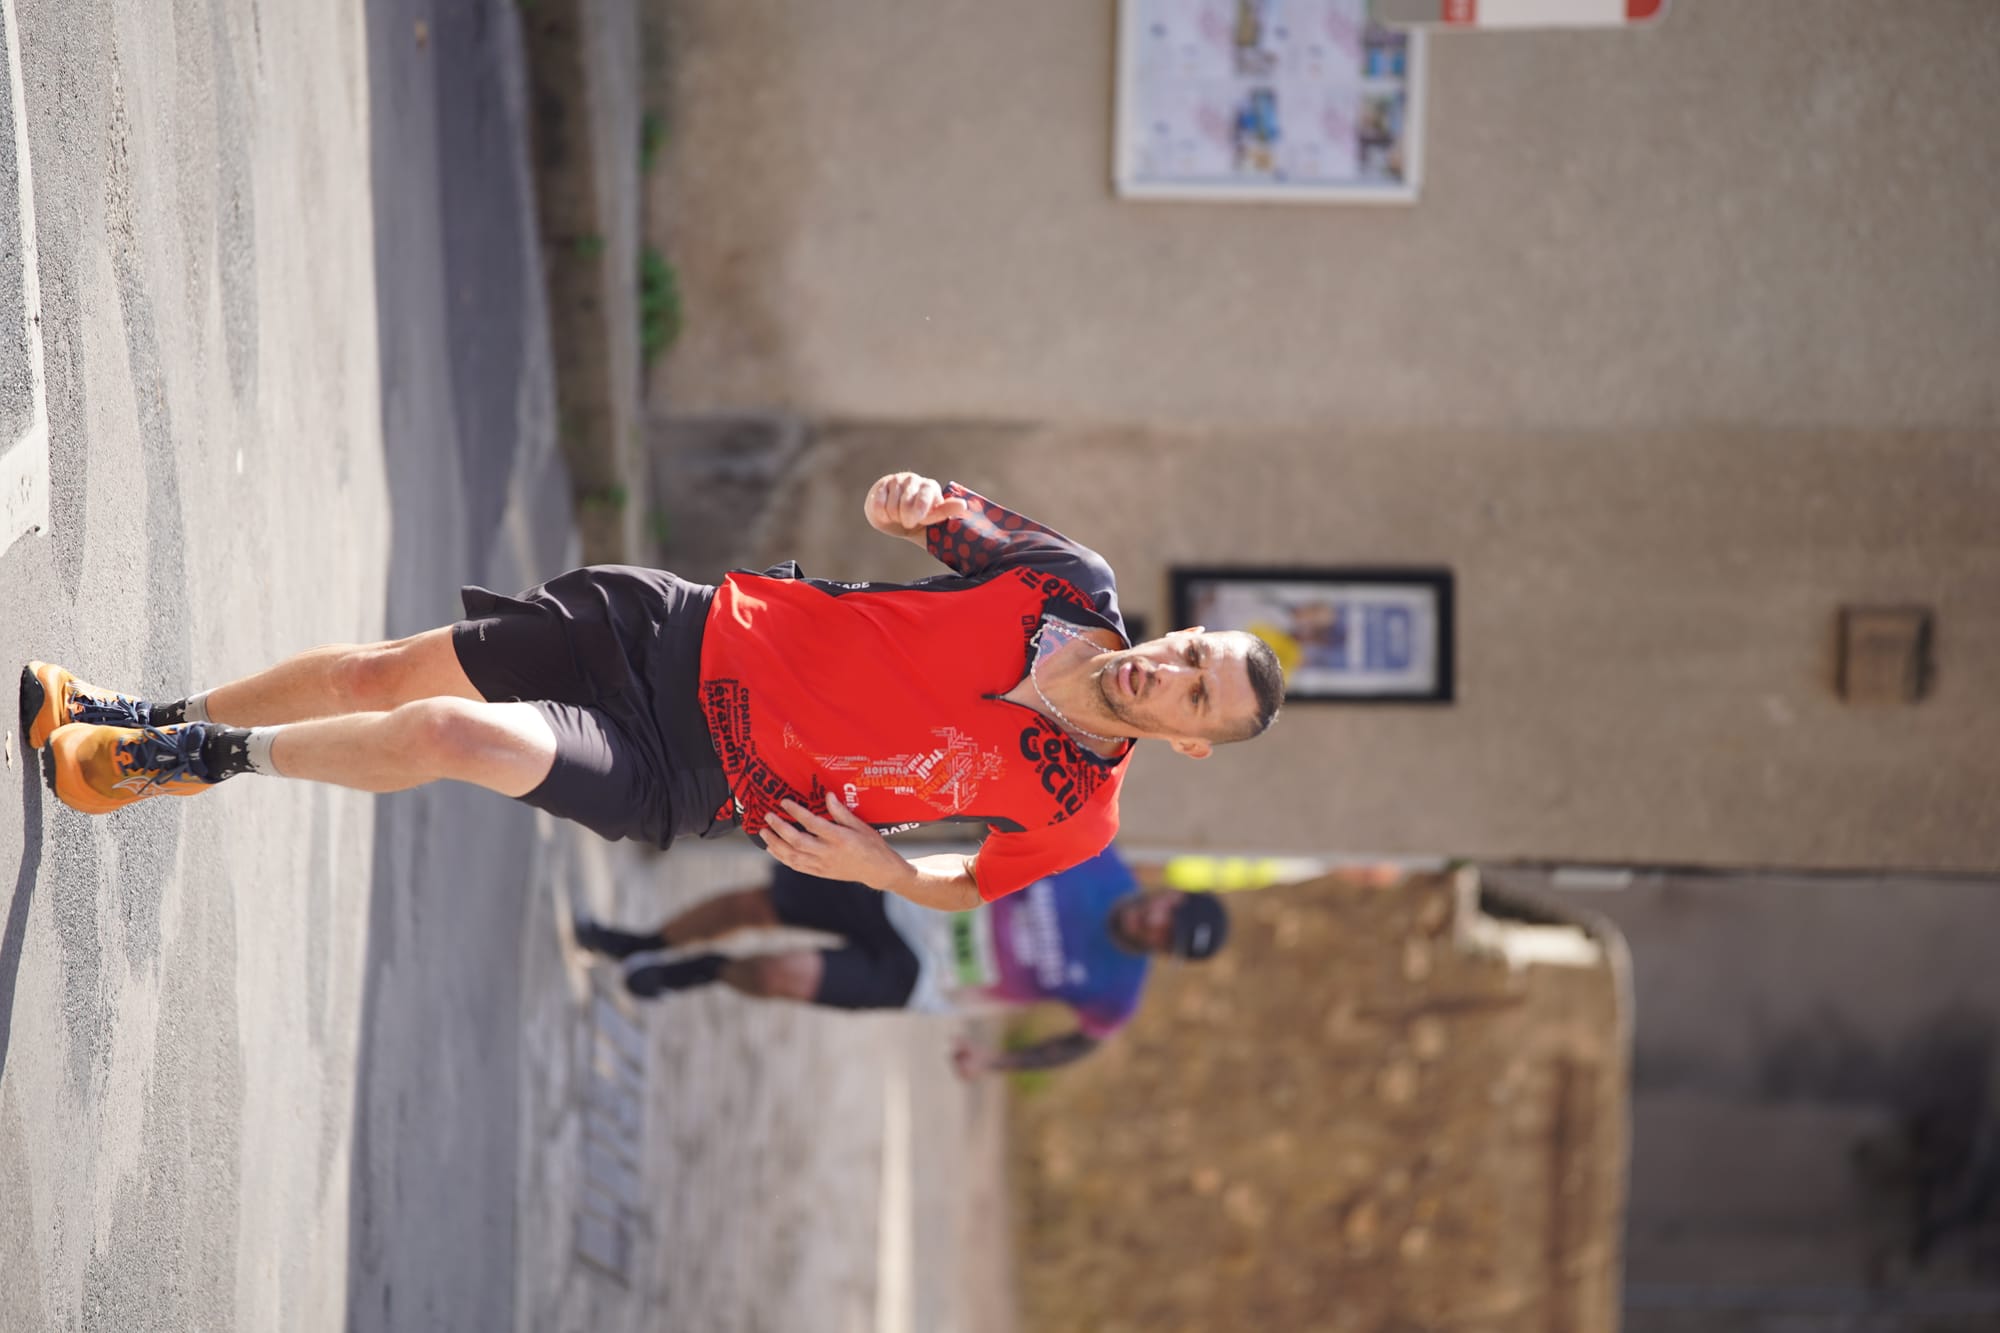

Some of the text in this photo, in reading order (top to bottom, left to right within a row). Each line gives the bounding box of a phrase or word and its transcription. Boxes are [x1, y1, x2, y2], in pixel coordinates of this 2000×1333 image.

[714, 686, 740, 768] évasion
[916, 748, 944, 780] trail
[878, 822, 920, 836] CEVE
